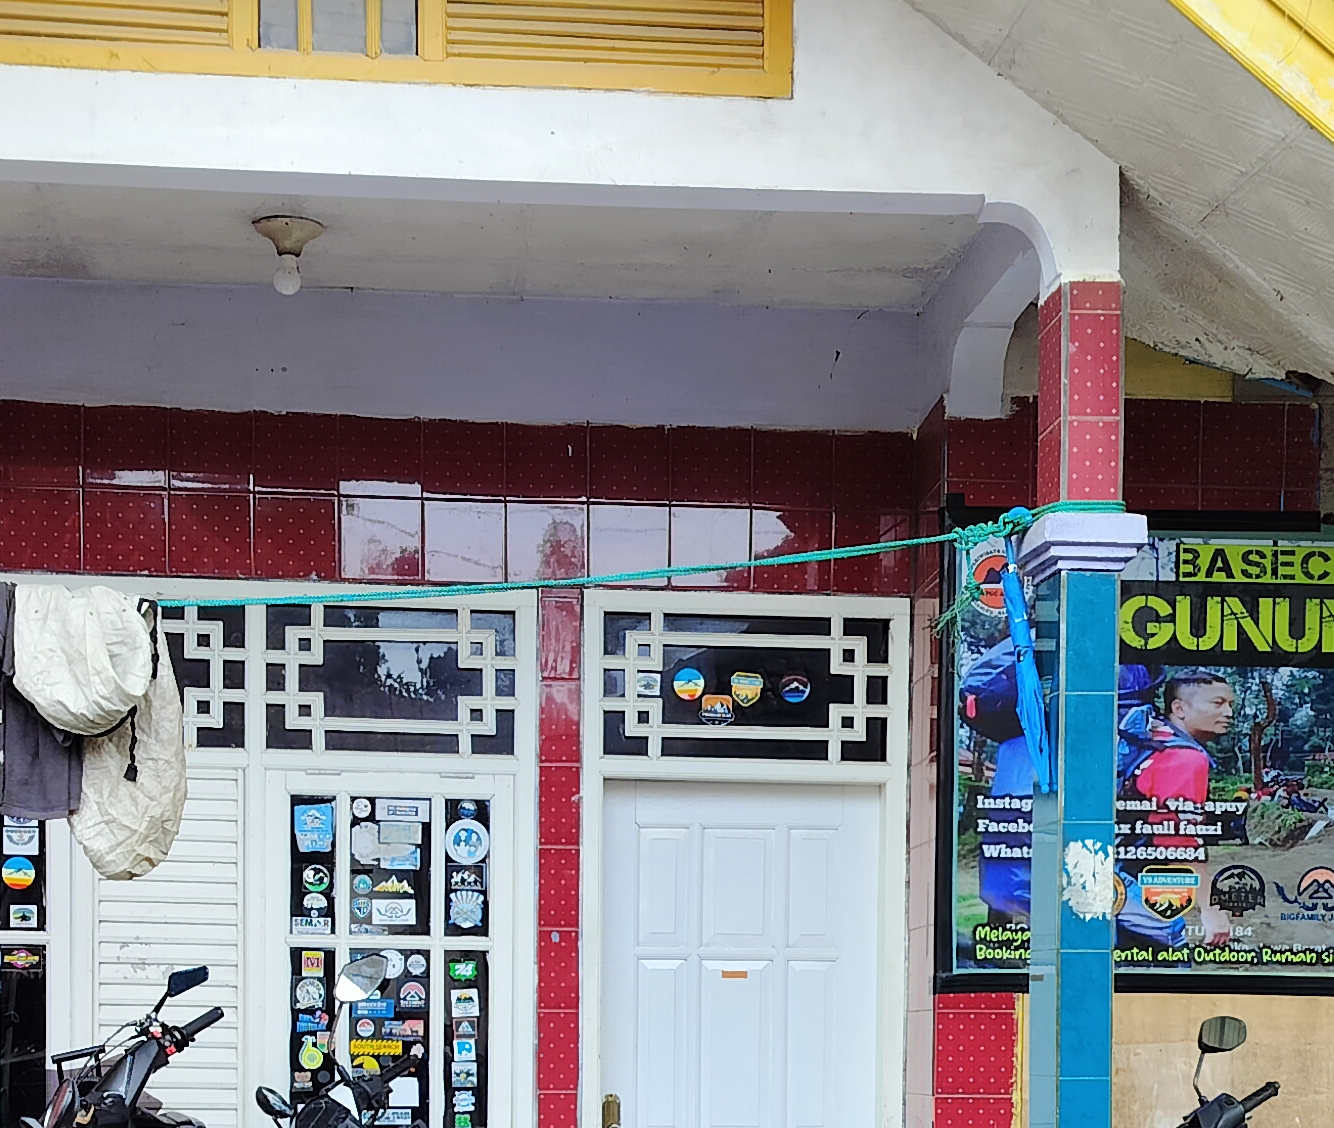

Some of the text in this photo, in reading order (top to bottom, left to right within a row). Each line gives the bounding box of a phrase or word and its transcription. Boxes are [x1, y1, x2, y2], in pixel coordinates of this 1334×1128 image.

[977, 795, 1033, 811] Instag
[1157, 948, 1189, 962] alat
[1193, 948, 1258, 964] Outdoor,
[1262, 949, 1317, 963] Rumah
